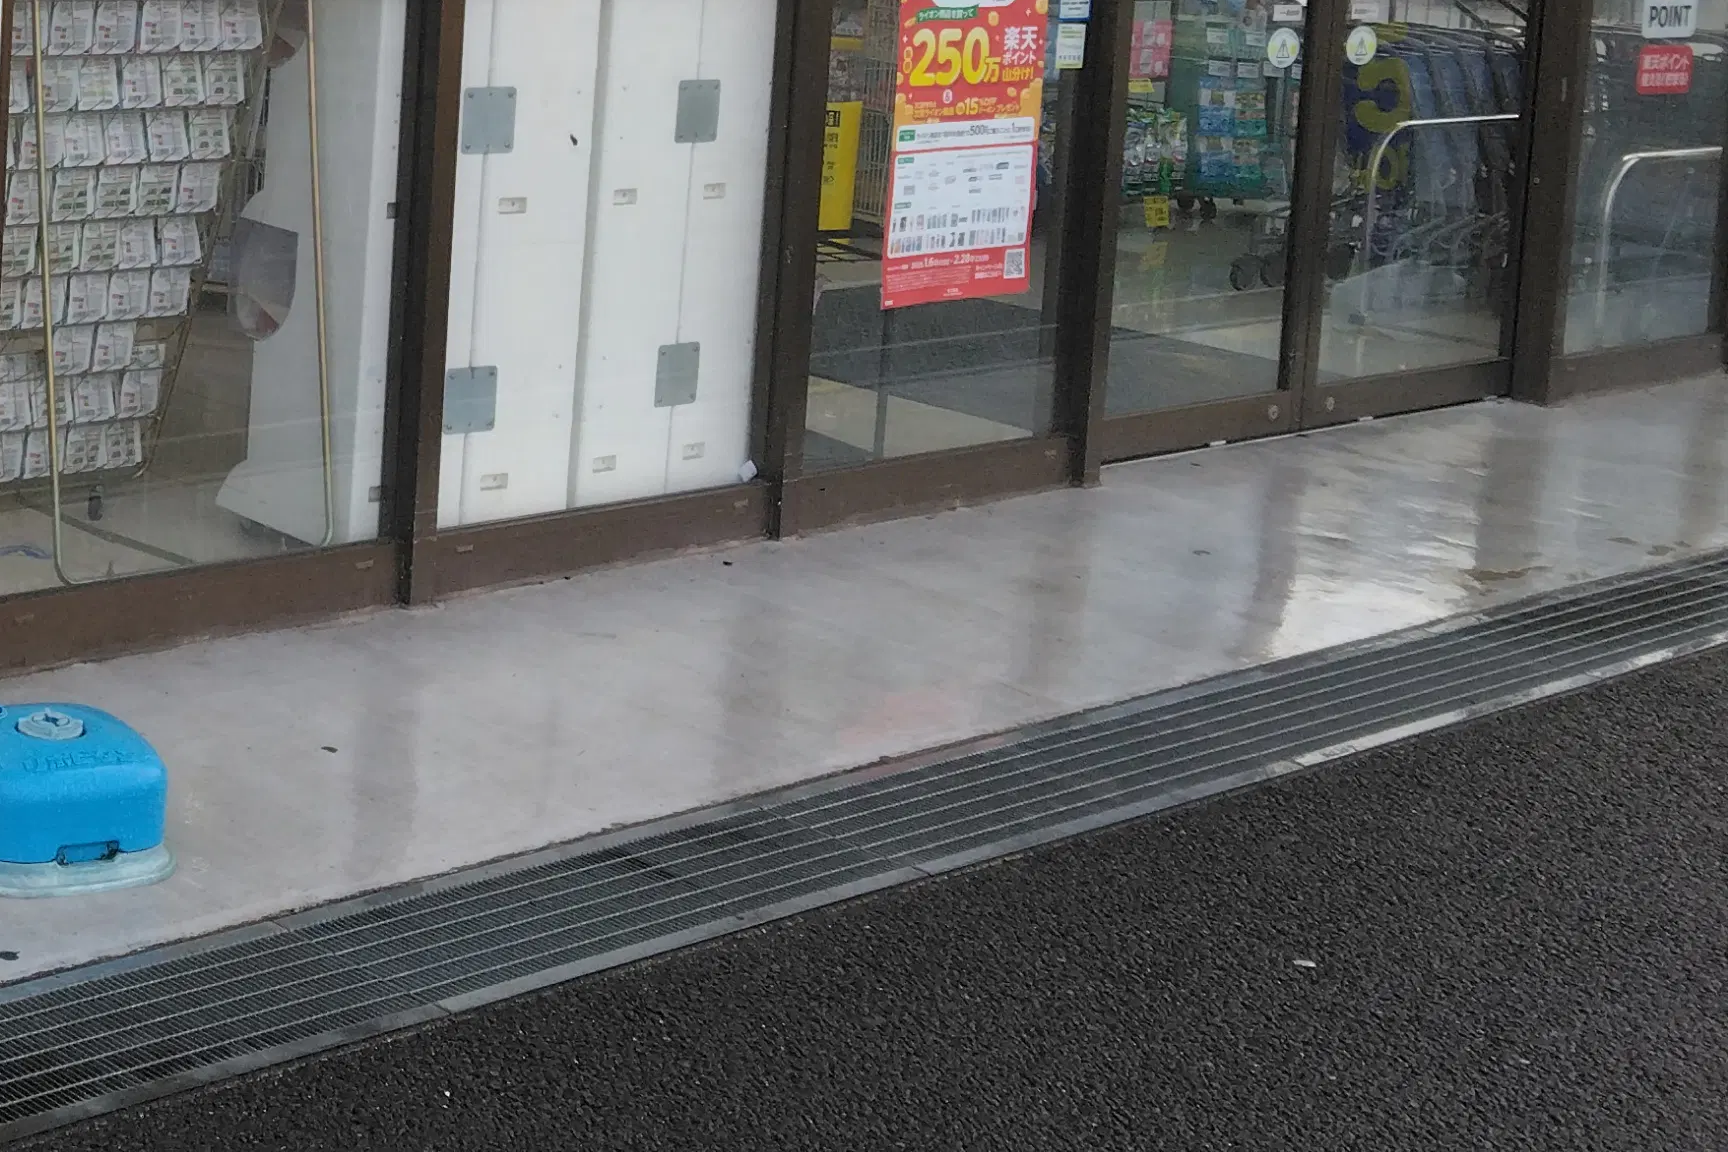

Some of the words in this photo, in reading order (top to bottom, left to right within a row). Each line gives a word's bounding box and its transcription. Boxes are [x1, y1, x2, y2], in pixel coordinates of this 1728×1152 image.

[1648, 5, 1692, 28] POINT
[1004, 26, 1039, 51] 楽天
[1003, 51, 1037, 66] ポイント
